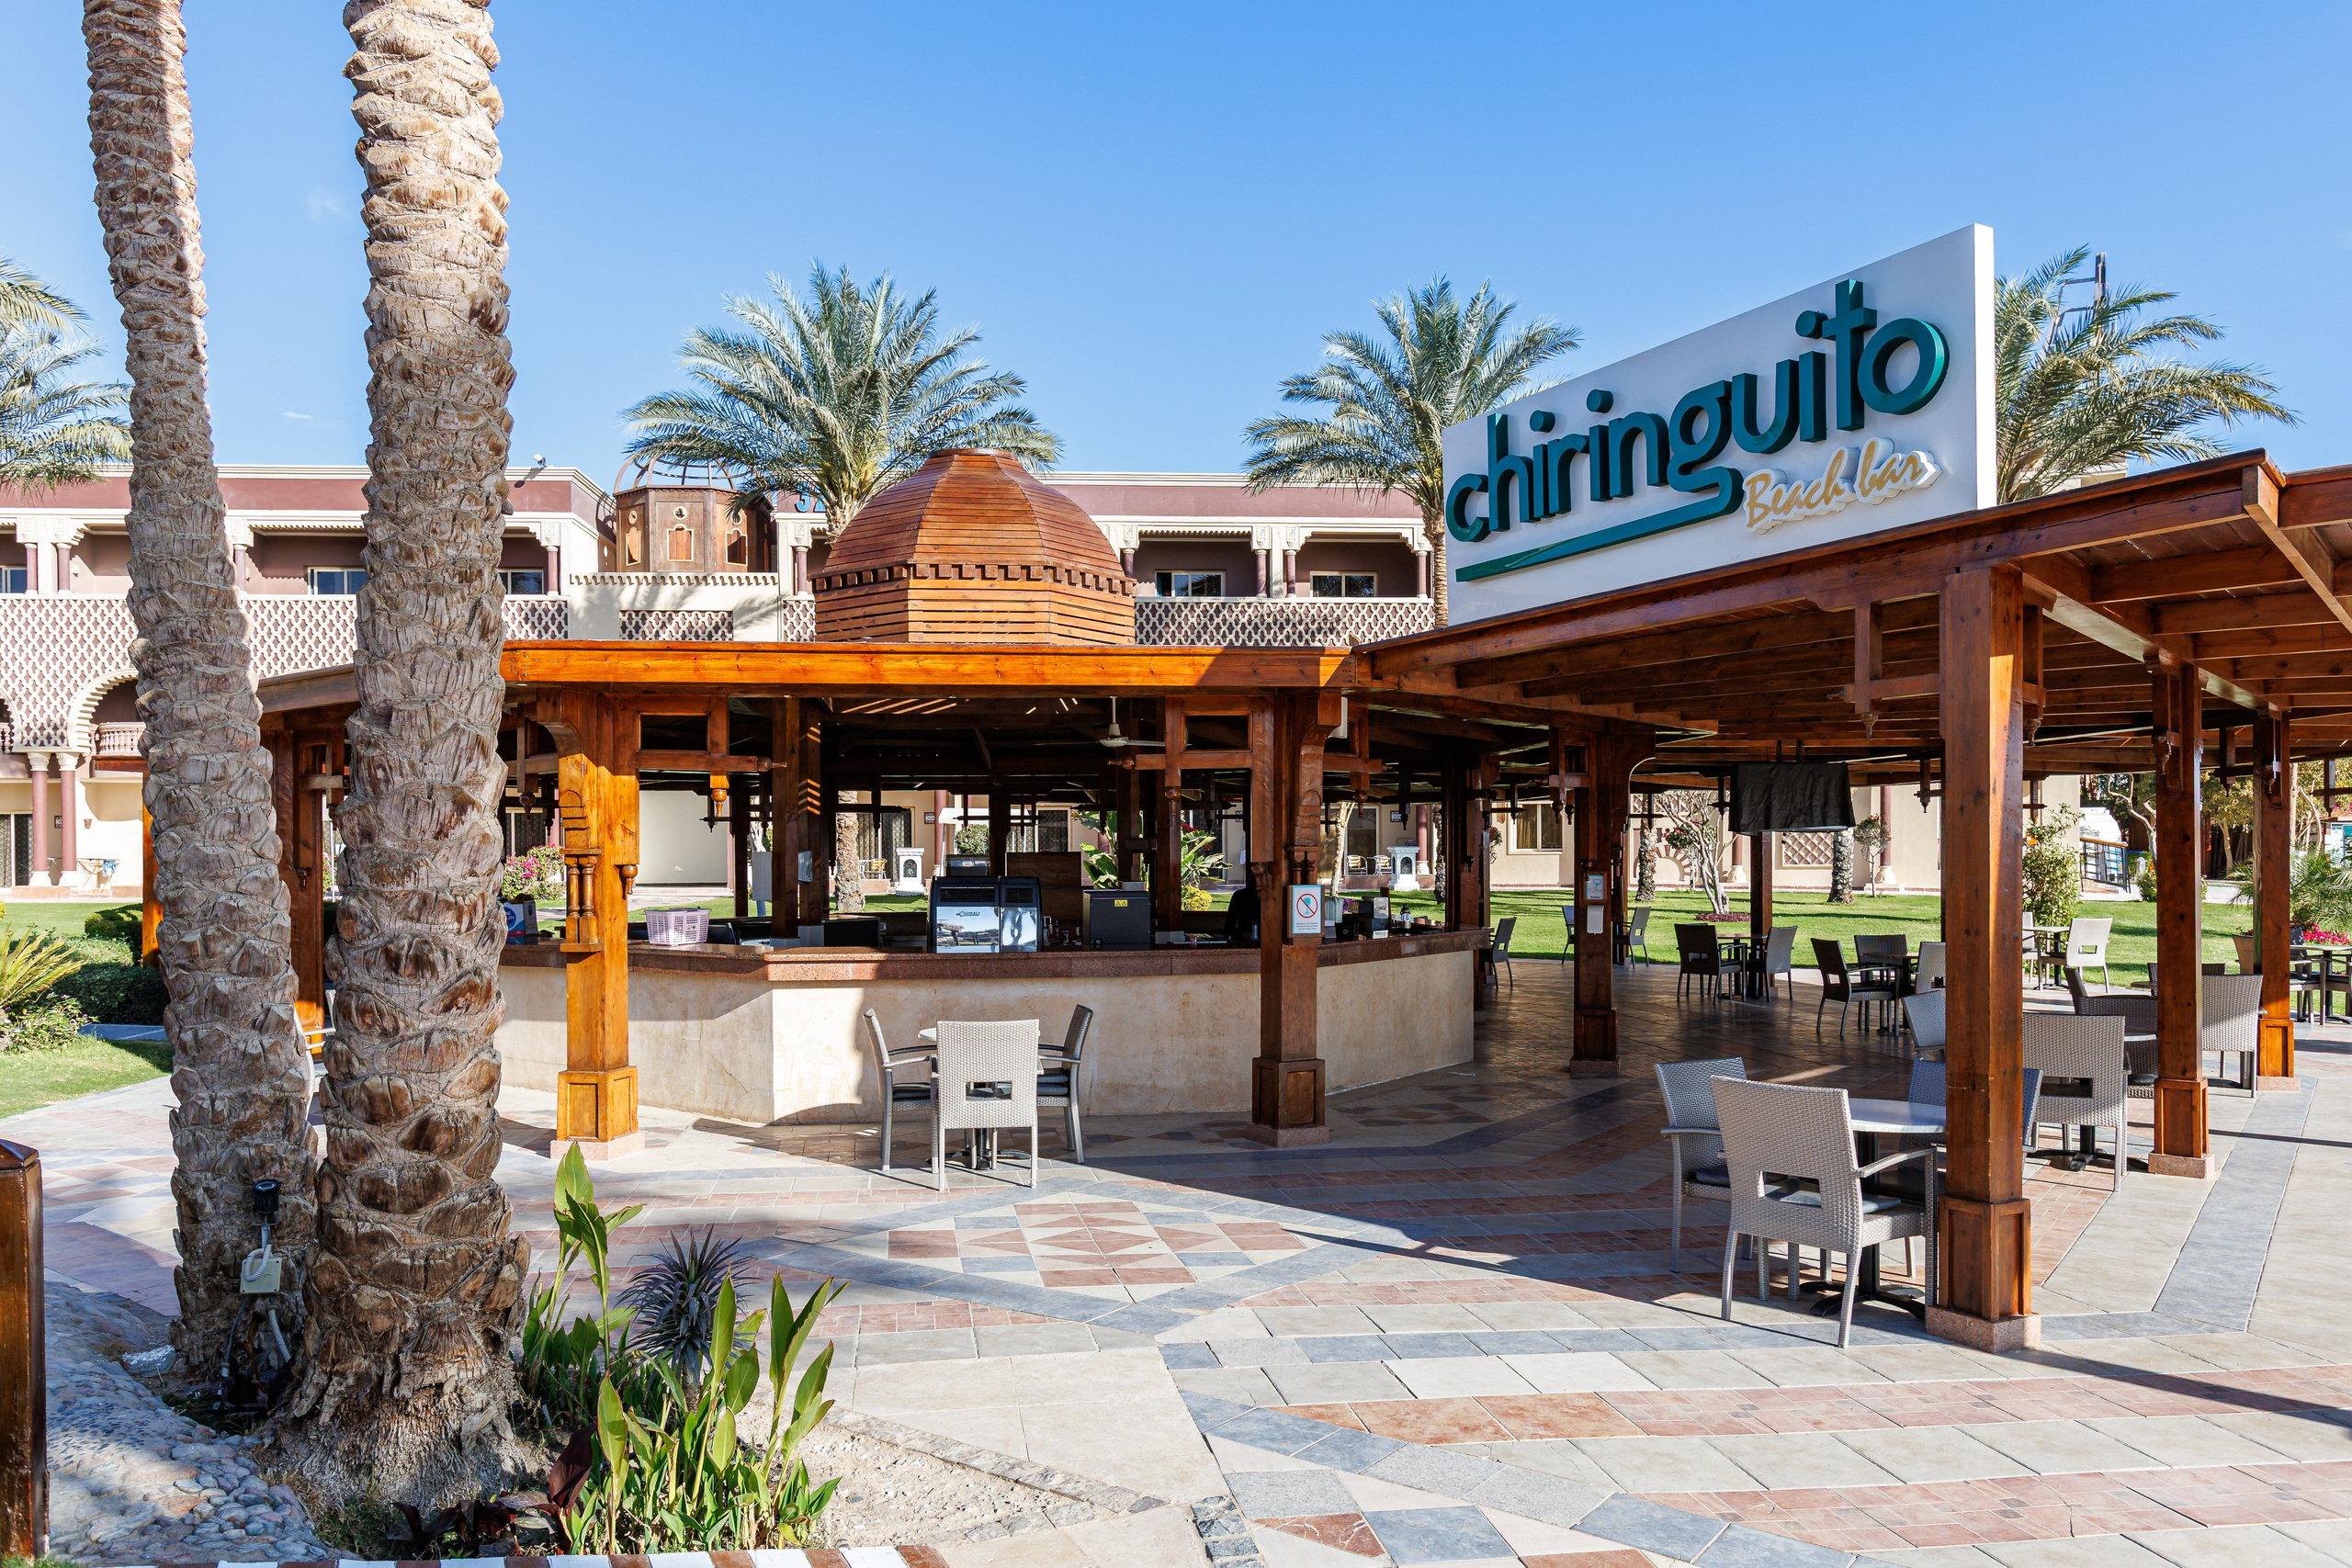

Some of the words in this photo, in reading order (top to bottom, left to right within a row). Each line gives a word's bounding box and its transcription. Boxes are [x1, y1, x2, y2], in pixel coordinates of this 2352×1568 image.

[1446, 279, 1950, 543] chiringuito
[1744, 447, 1849, 530] Beach
[1856, 438, 1927, 499] bar
